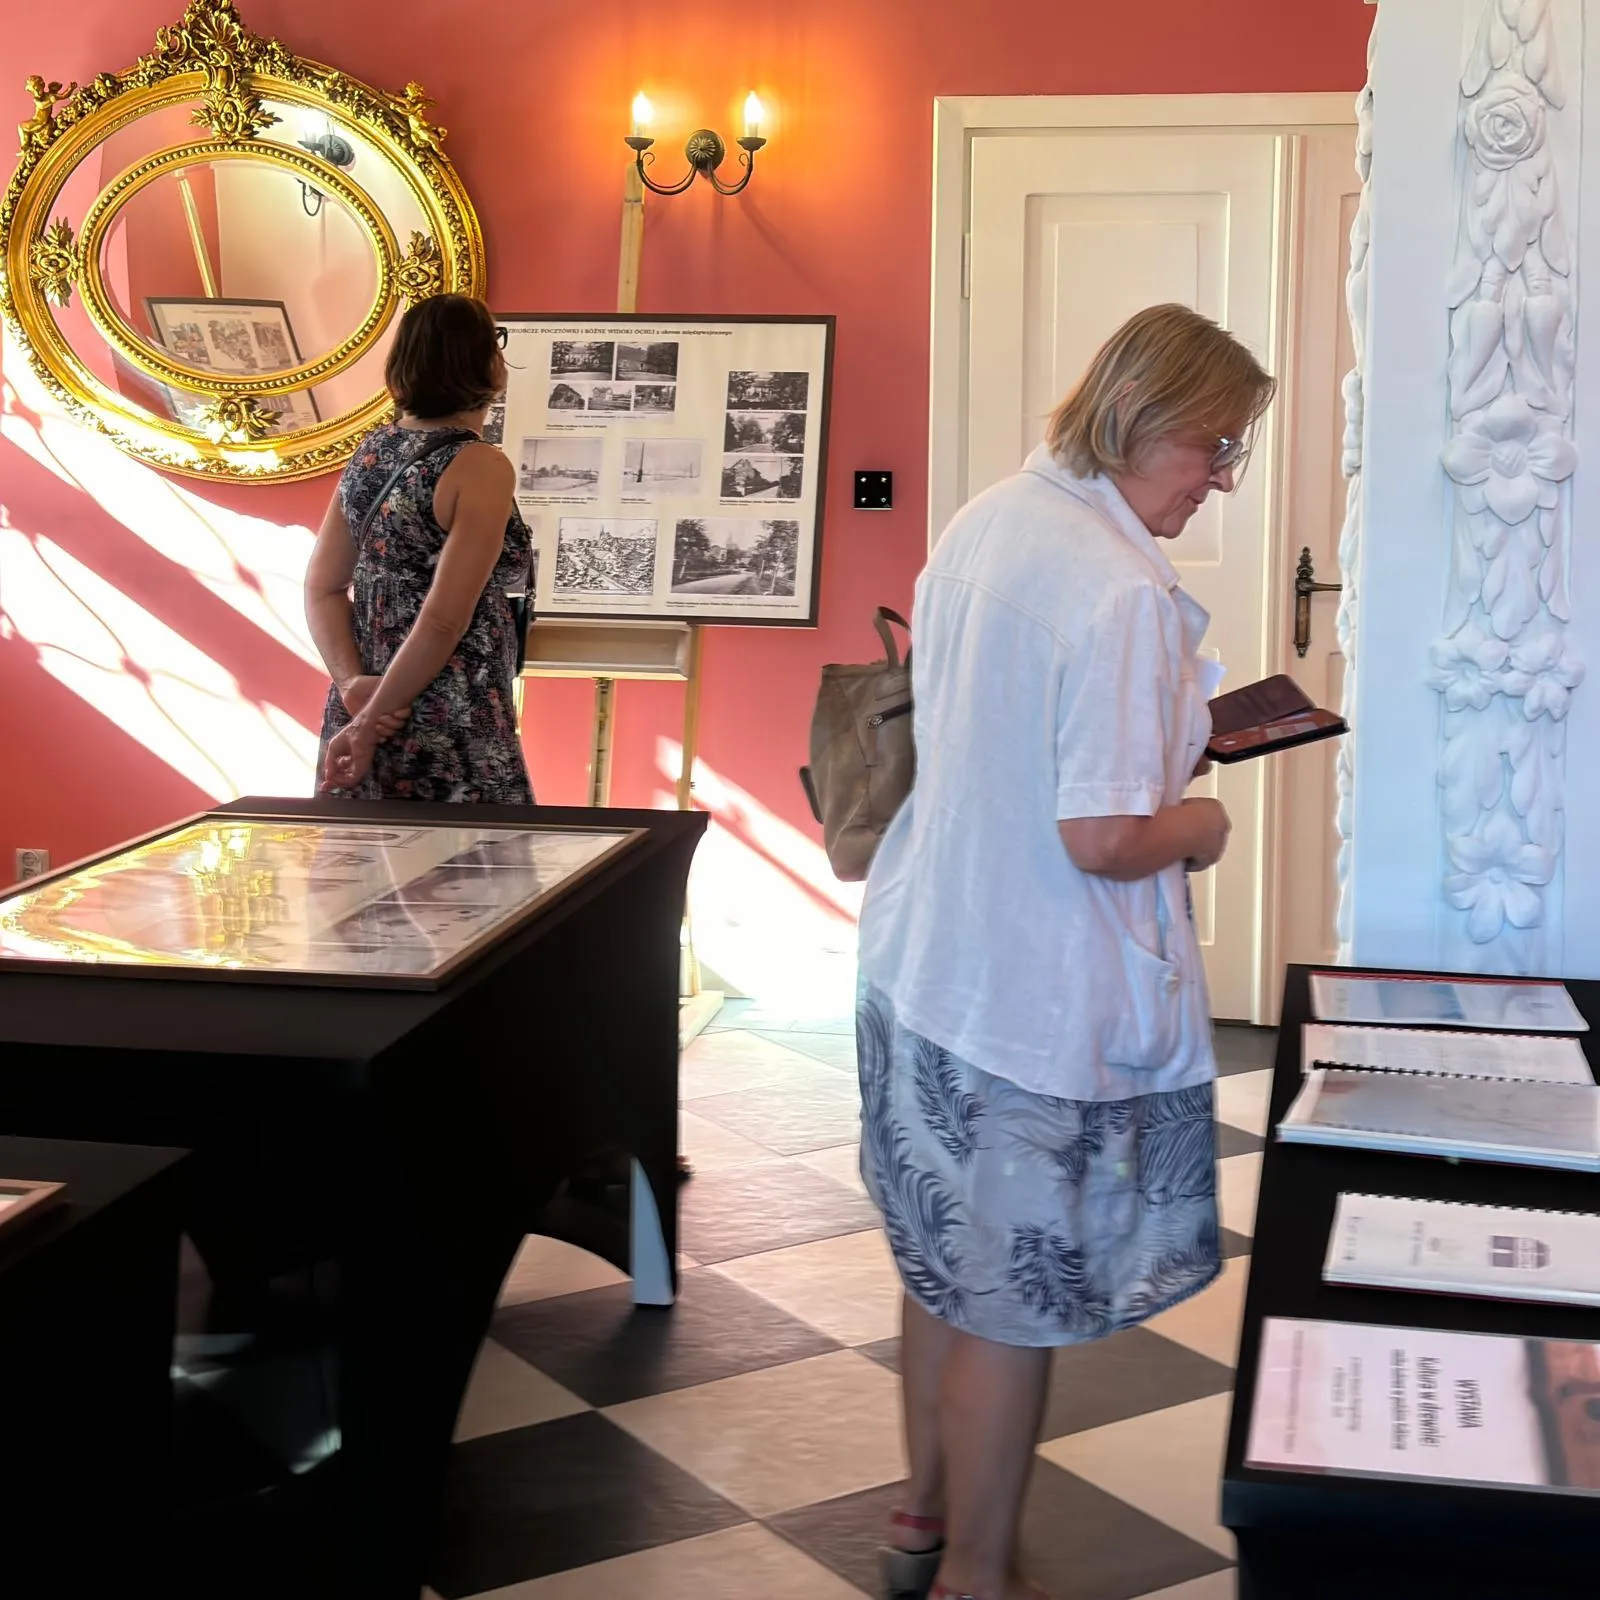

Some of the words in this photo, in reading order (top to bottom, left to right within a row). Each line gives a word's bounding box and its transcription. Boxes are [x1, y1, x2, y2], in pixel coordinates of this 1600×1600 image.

[1416, 1357, 1441, 1389] Kultura
[1418, 1391, 1439, 1401] w
[1455, 1379, 1483, 1428] WYSTAWA
